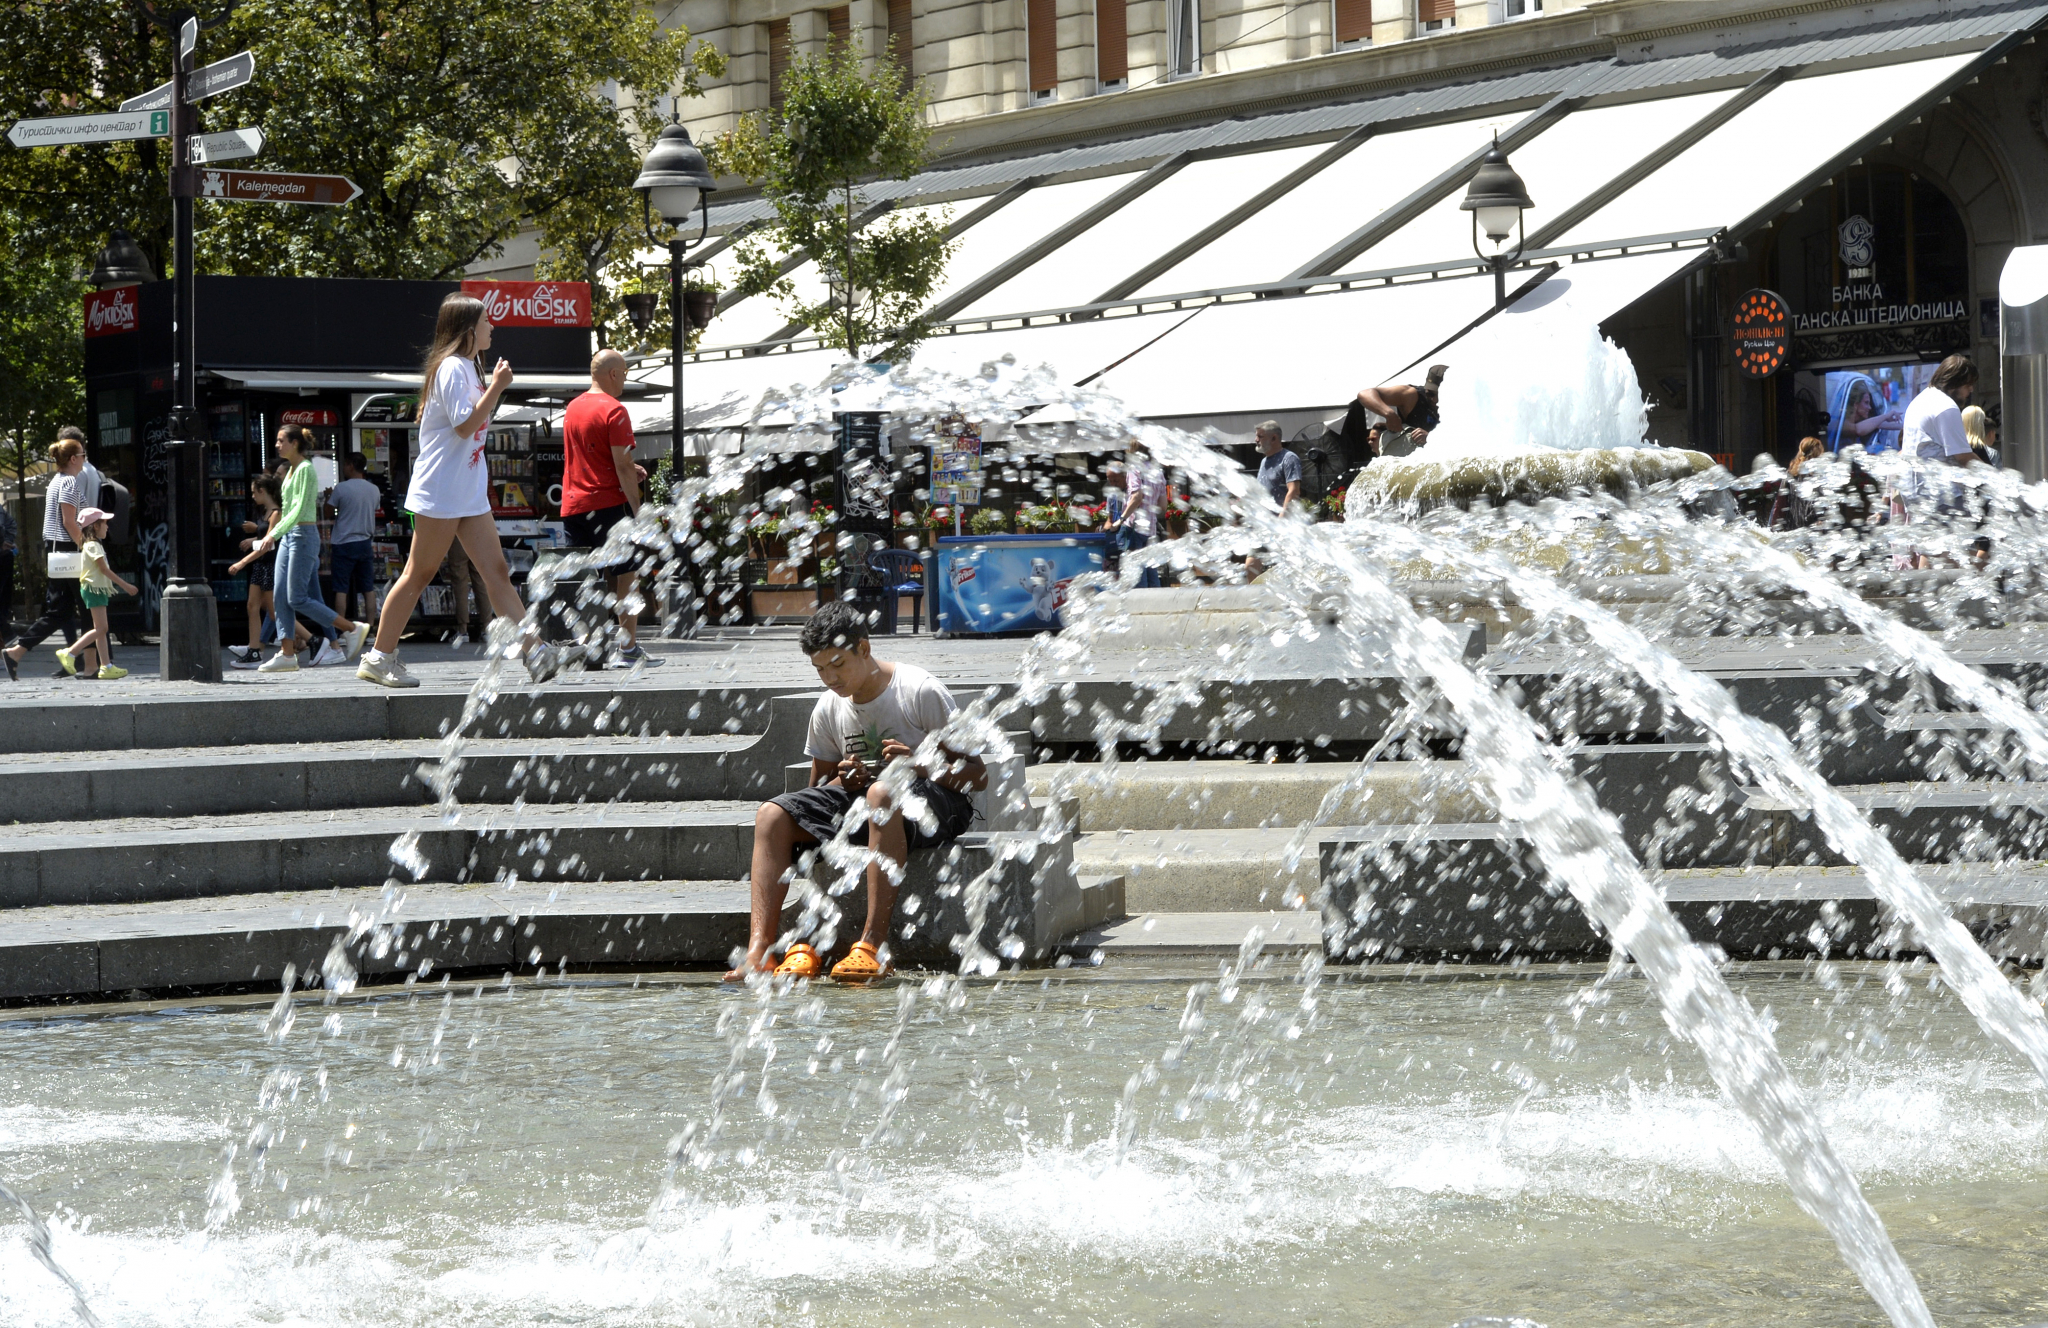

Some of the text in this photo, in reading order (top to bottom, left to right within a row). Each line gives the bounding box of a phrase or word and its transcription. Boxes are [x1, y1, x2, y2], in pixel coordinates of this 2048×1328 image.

[18, 120, 143, 139] Туристички инфо центар 1
[207, 140, 246, 154] Republic Square
[237, 180, 305, 194] Kalemegdan
[1832, 283, 1883, 302] БАНКА
[513, 299, 577, 318] KIOSK
[1792, 310, 1850, 330] ТАНСКА
[1855, 300, 1966, 325] ШТЕДИОНИЦА
[282, 411, 315, 423] Coca-Cola
